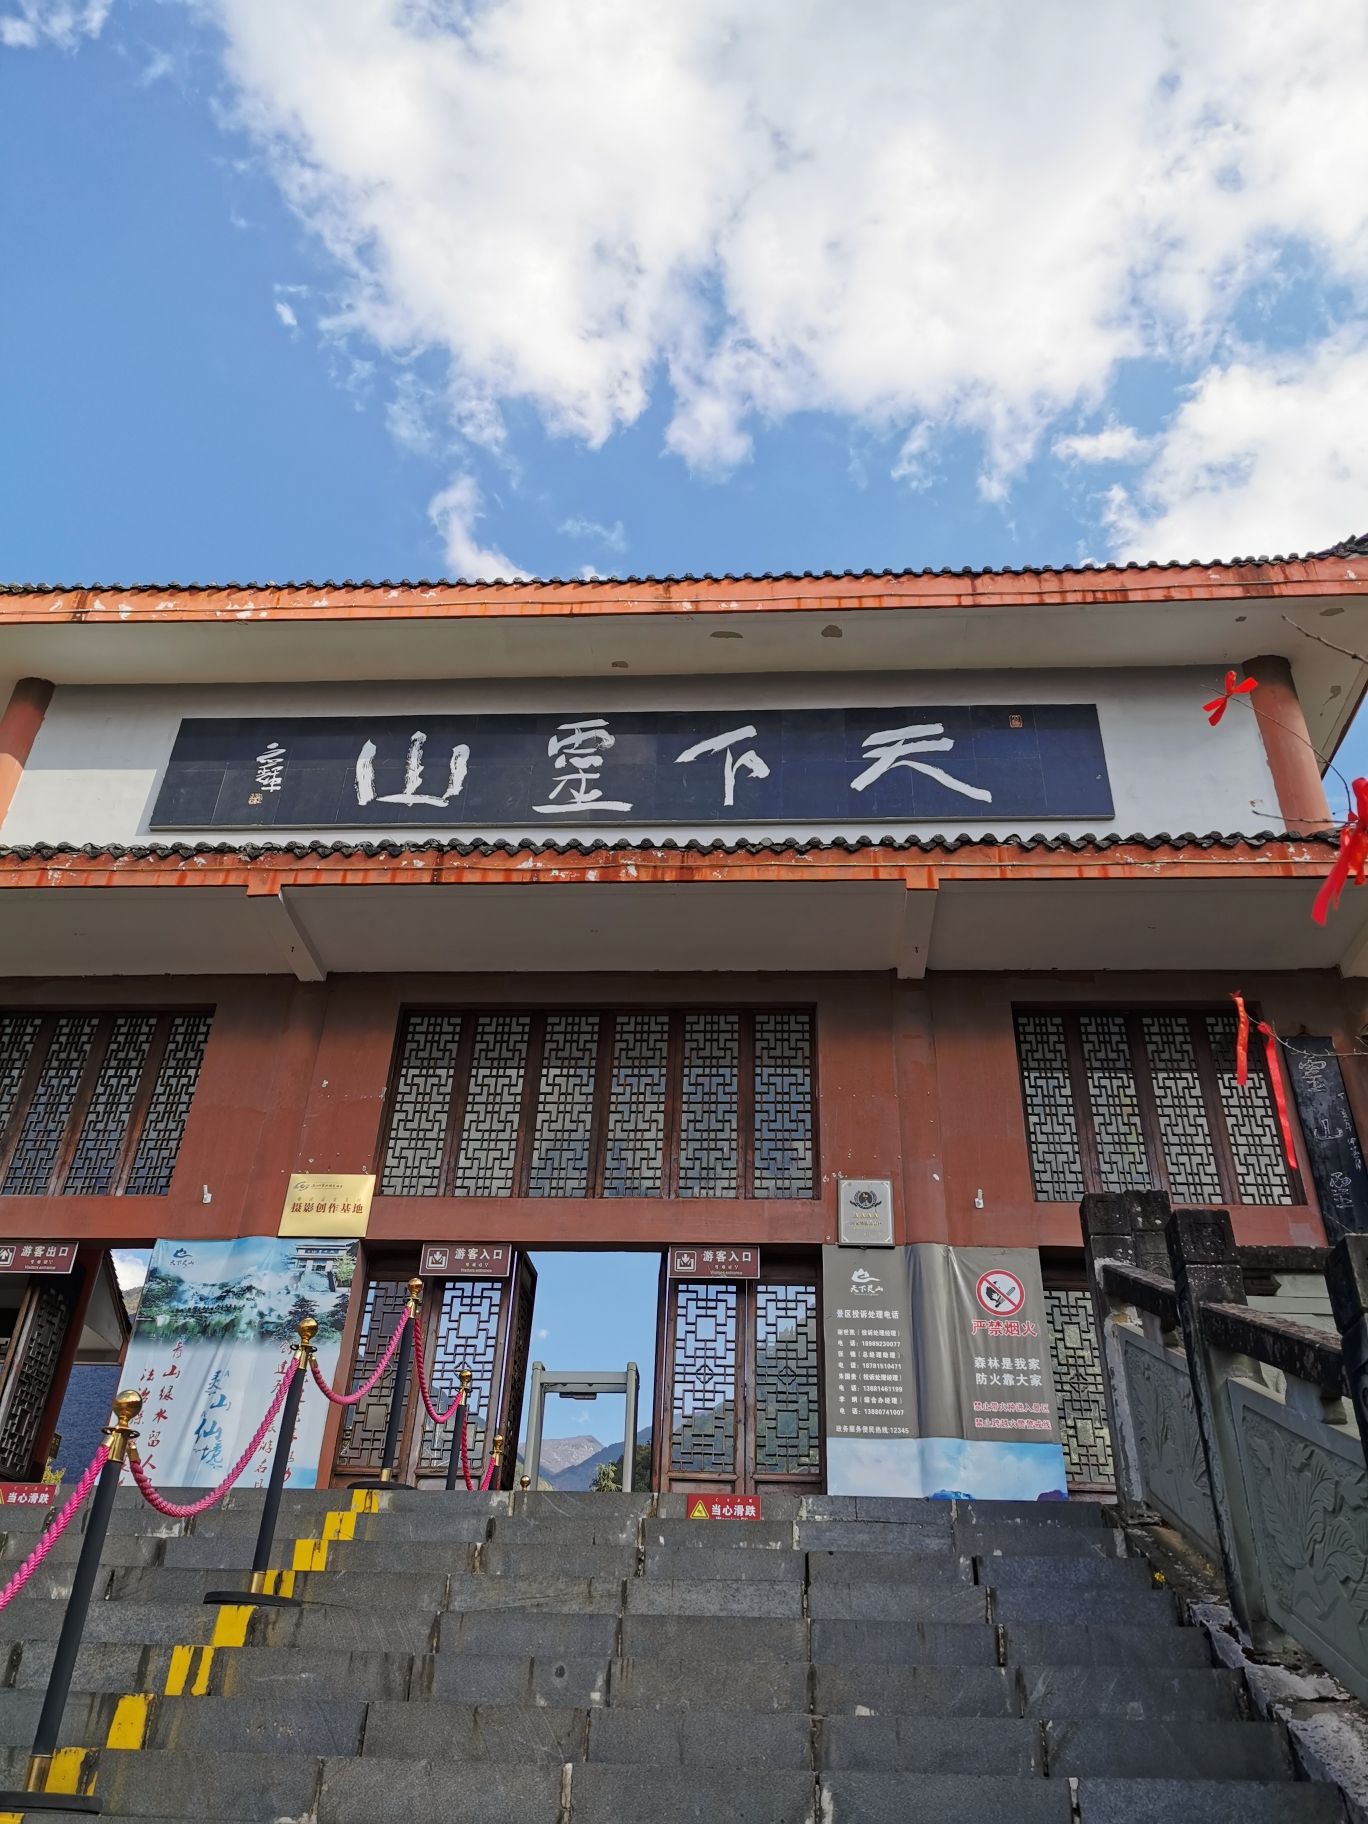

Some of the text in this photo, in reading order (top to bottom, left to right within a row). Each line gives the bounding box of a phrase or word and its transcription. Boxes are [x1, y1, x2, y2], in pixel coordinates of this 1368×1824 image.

[290, 1202, 364, 1214] 摄影创作基地
[20, 1245, 70, 1258] 游客出口
[454, 1248, 503, 1260] 游客入口
[702, 1250, 752, 1262] 游客入口
[836, 1309, 900, 1320] 景区投诉处理电话
[971, 1319, 1039, 1338] 严禁烟火
[974, 1356, 1042, 1370] 森林是我家
[975, 1372, 1043, 1387] 防火靠大家
[192, 1368, 231, 1469] 灵山仙境
[7, 1491, 50, 1504] 当心滑跌
[711, 1503, 757, 1517] 当心滑跌
